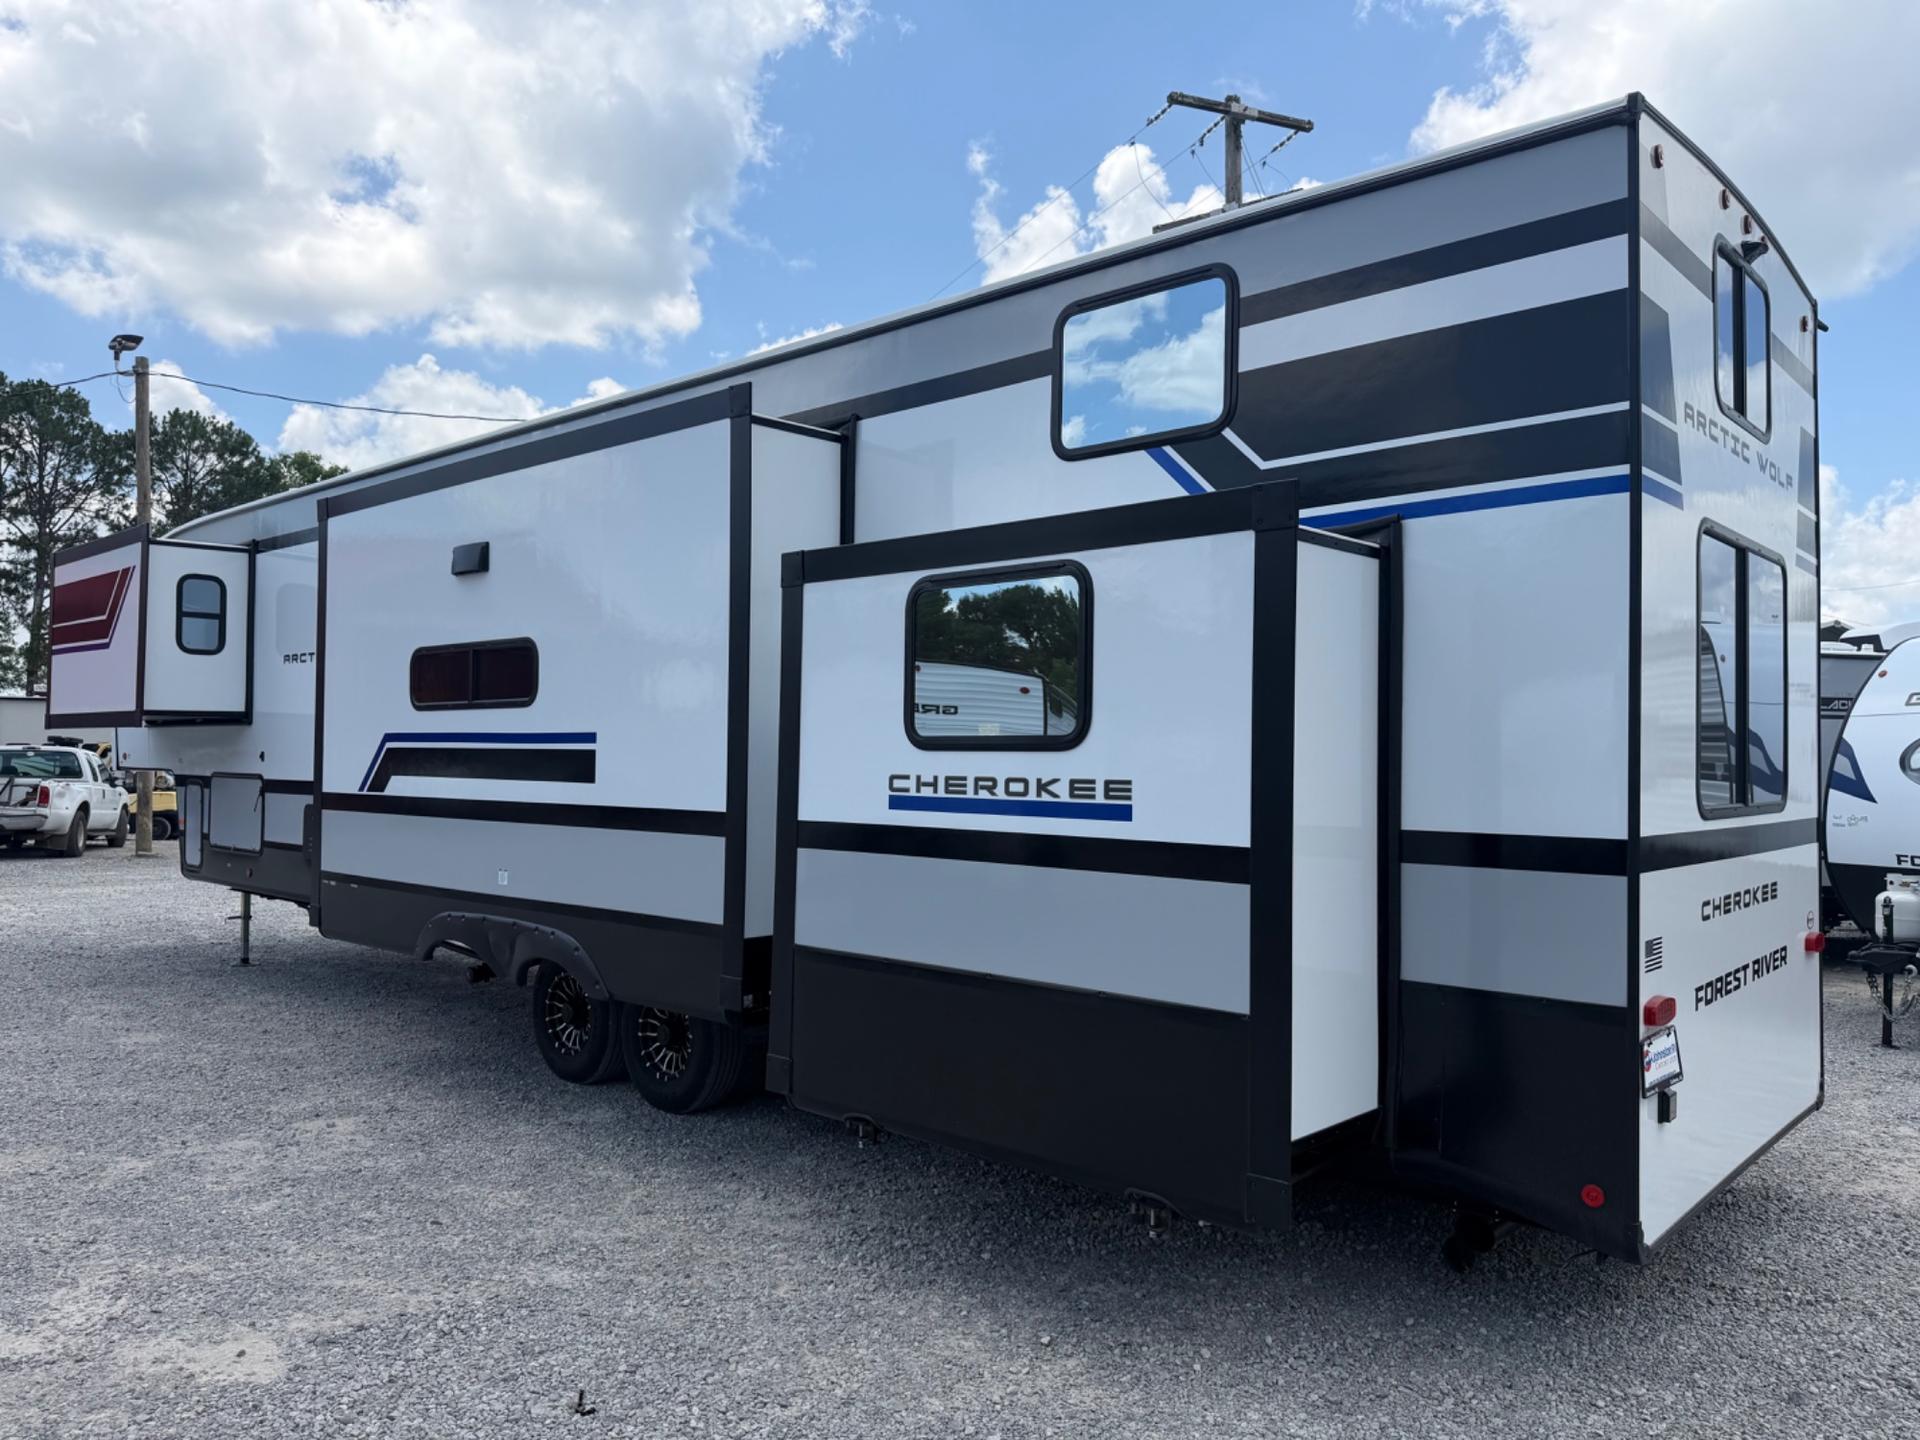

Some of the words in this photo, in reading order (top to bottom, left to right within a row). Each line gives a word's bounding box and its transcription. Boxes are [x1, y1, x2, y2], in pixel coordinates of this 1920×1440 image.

[1684, 401, 1751, 465] ARCTIC
[1756, 450, 1793, 490] WOLF
[888, 774, 1133, 801] CHEROKEE
[1701, 881, 1778, 922] CHEROKEE
[1694, 962, 1750, 1012] FOREST
[1752, 945, 1788, 982] RIVER
